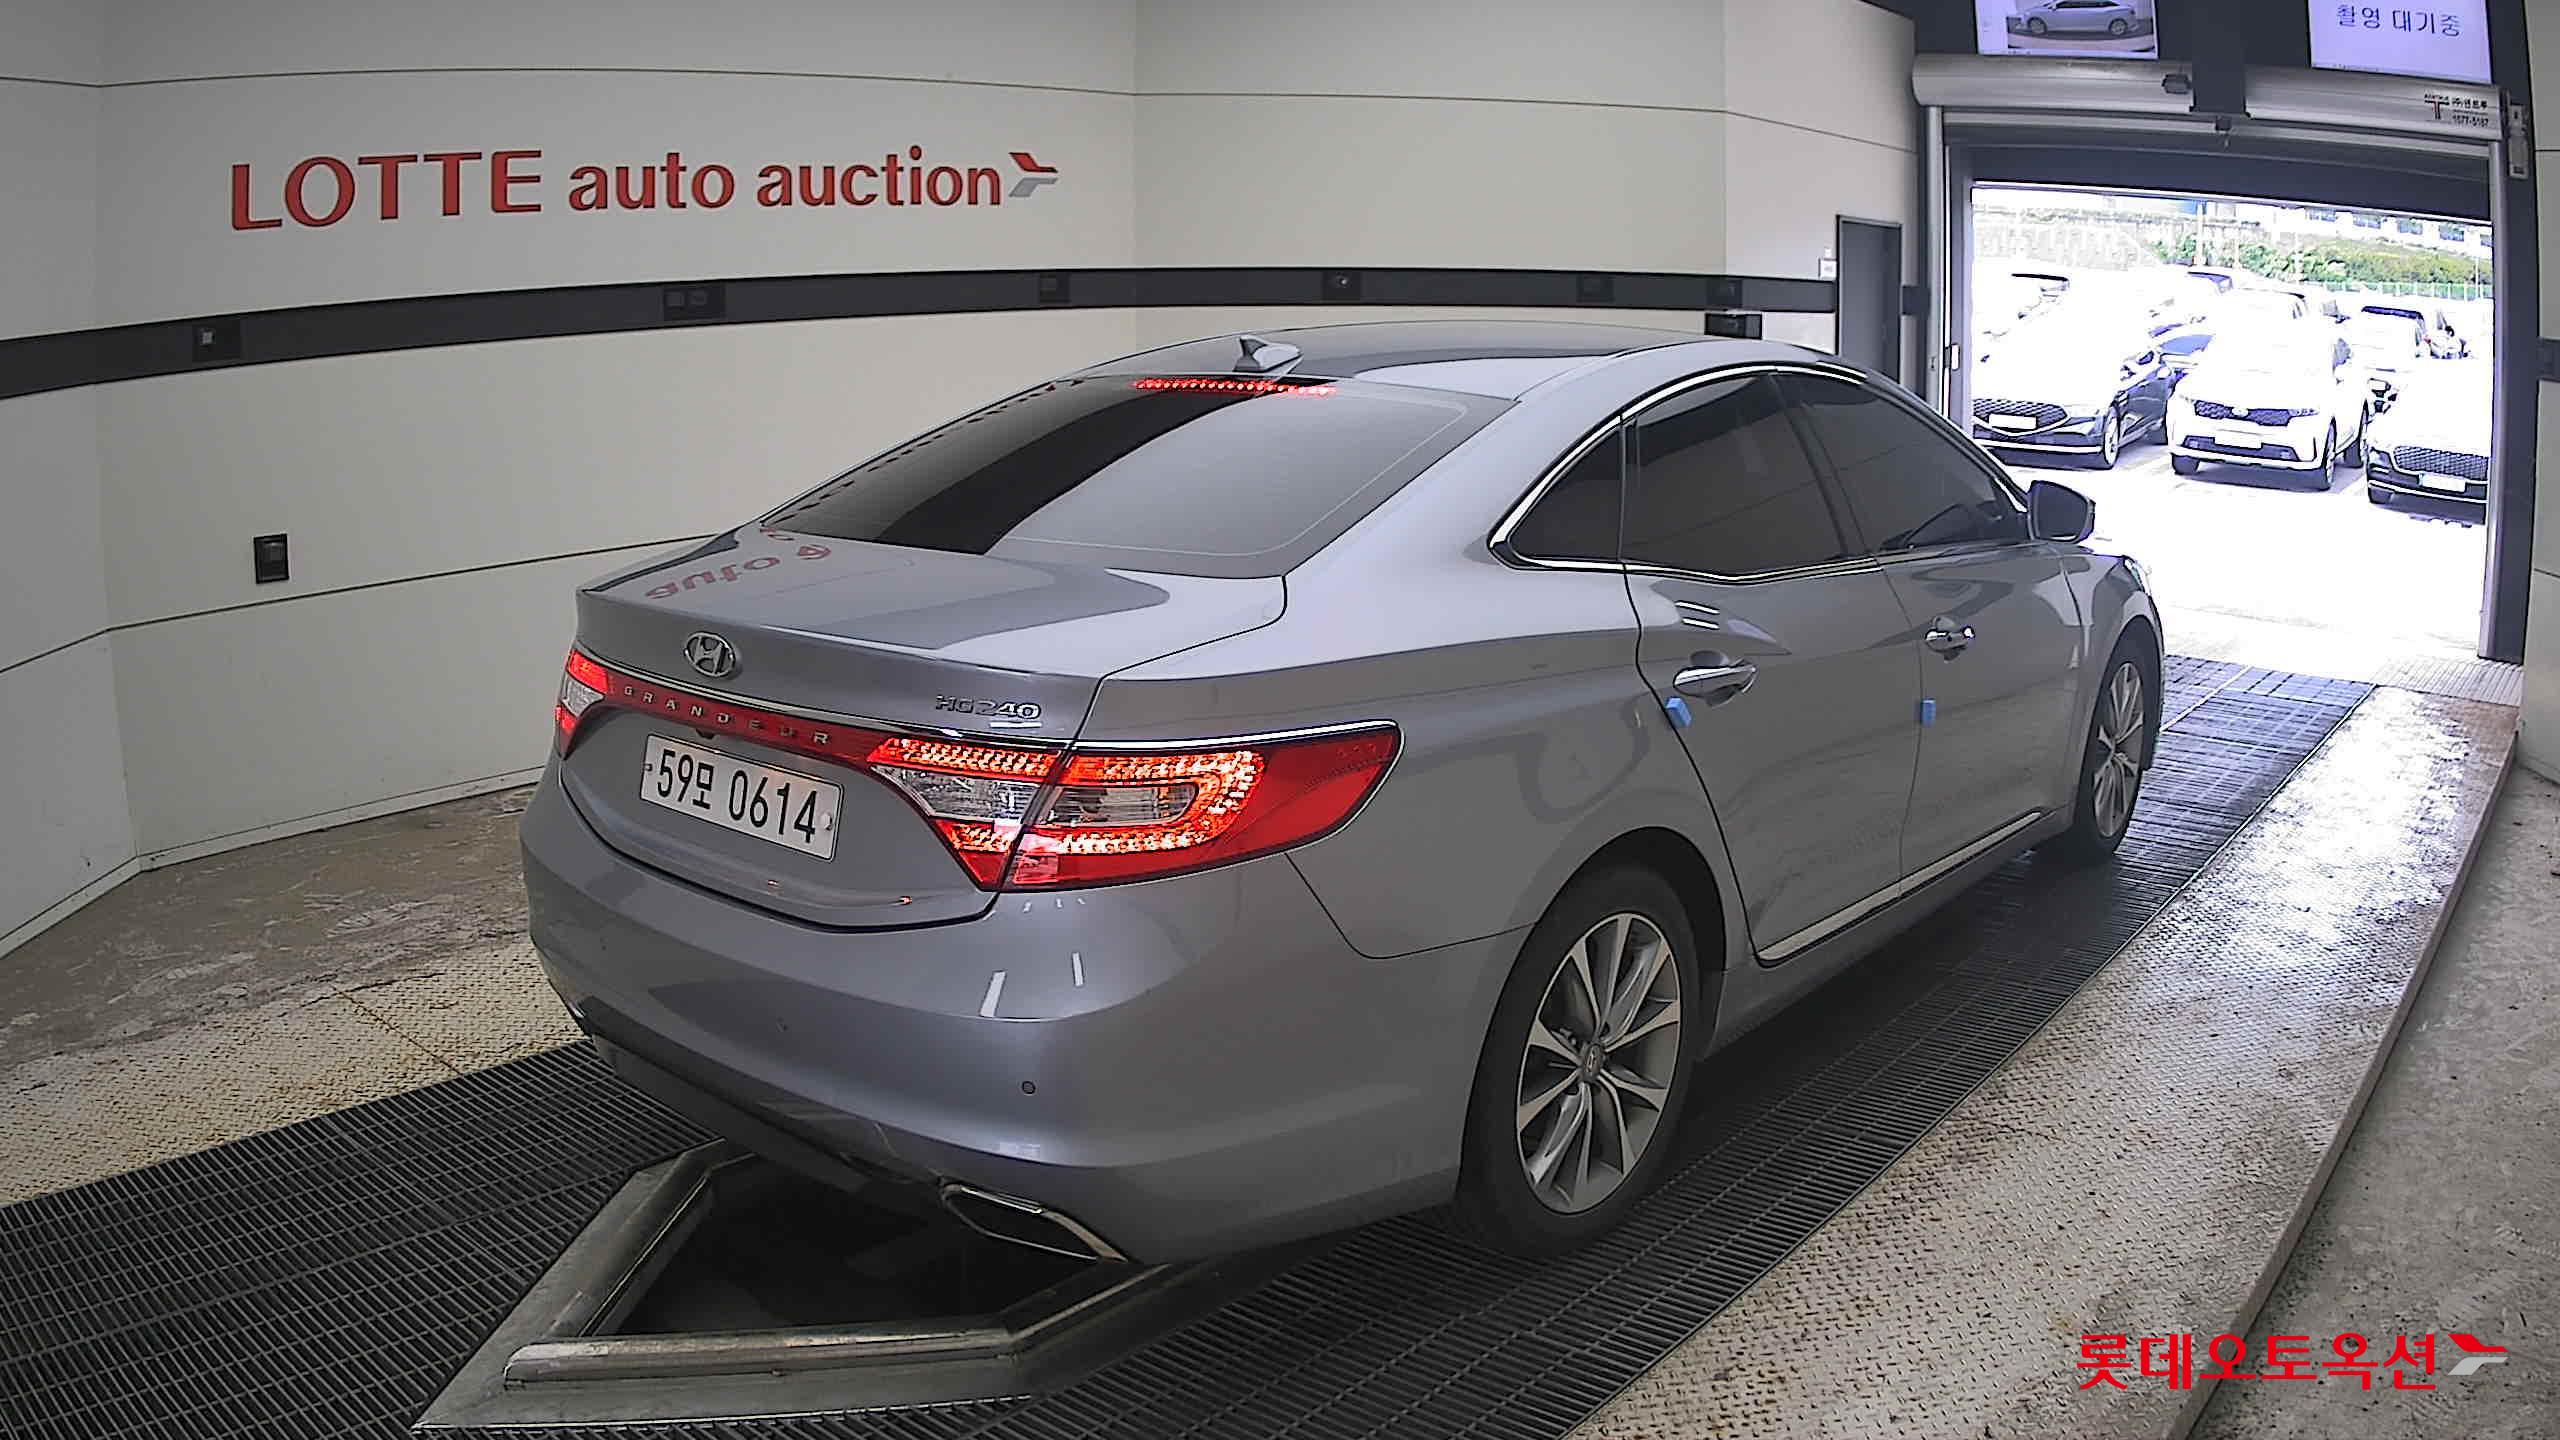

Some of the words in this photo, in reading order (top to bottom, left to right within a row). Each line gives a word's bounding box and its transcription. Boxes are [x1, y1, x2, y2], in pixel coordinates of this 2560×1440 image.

[2337, 4, 2381, 30] 촬영
[2392, 9, 2461, 37] 대기중
[231, 149, 543, 231] LOTTE
[568, 152, 736, 212] auto
[756, 145, 1003, 208] auction
[623, 685, 831, 745] GRANDEUR
[935, 694, 1042, 720] HG240
[657, 748, 715, 810] 59모
[728, 769, 818, 844] 0614
